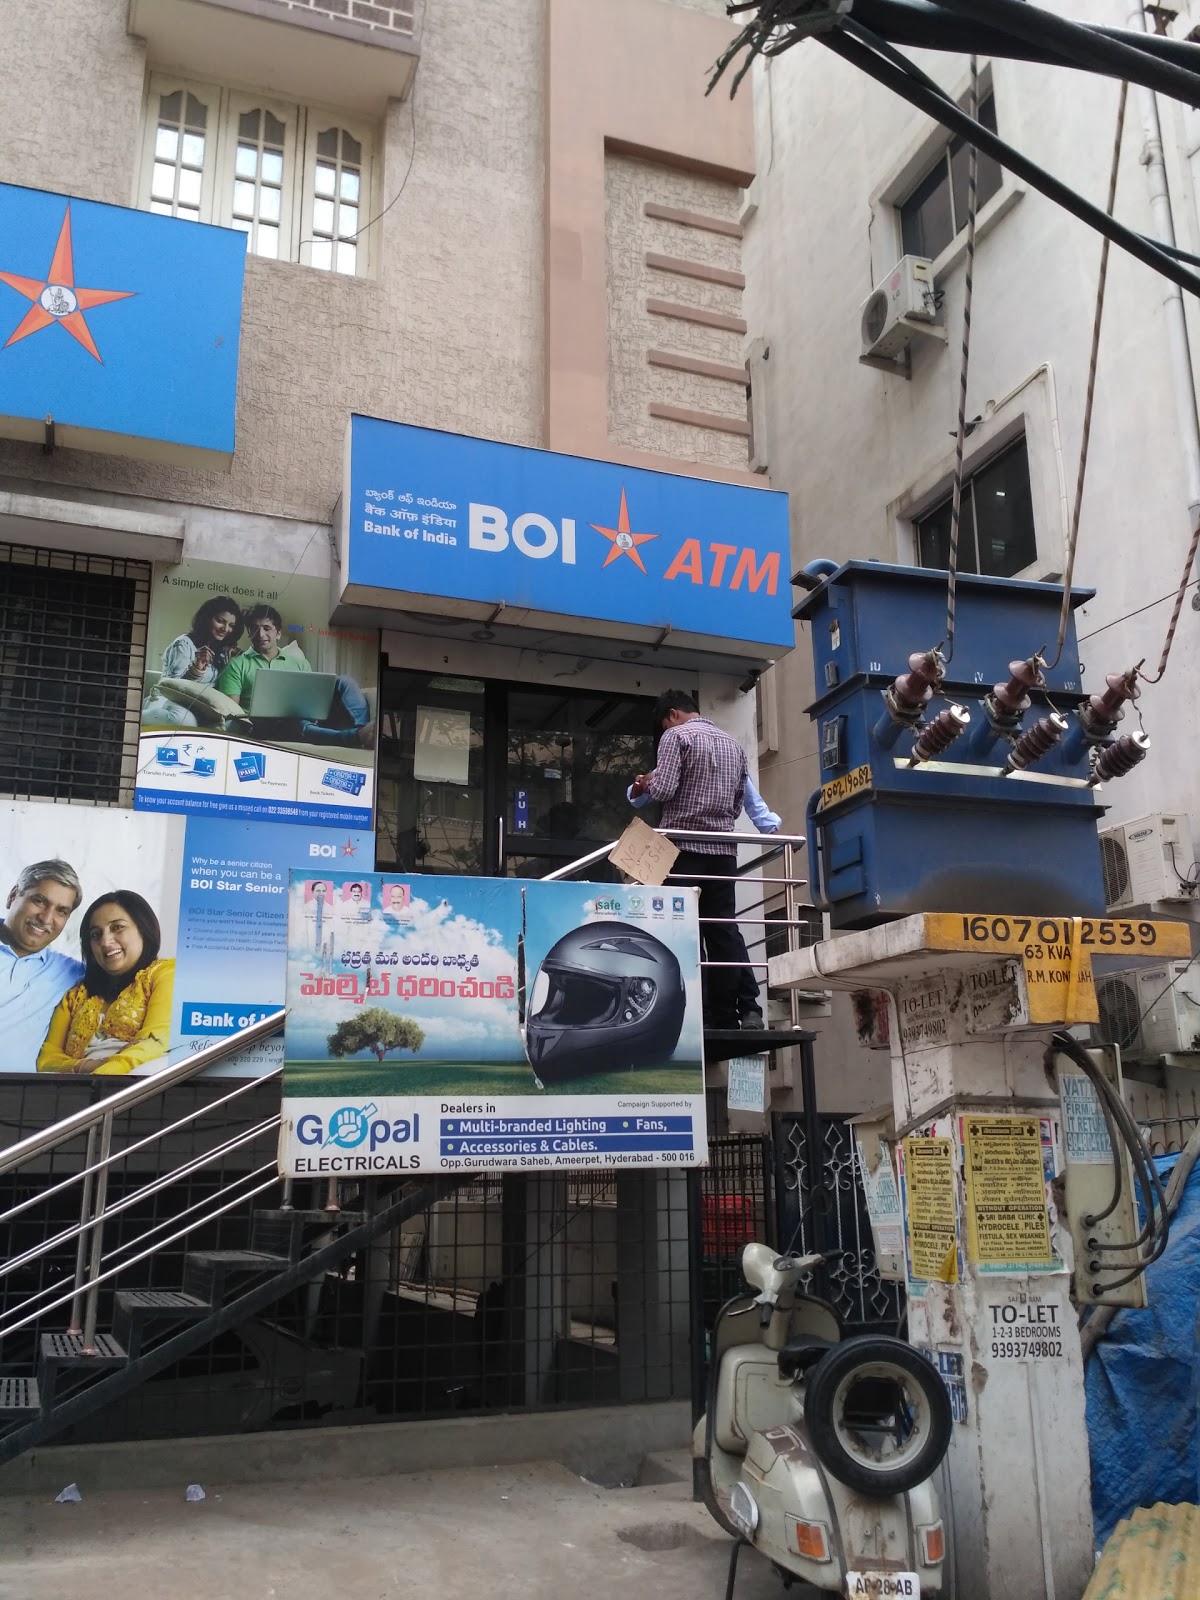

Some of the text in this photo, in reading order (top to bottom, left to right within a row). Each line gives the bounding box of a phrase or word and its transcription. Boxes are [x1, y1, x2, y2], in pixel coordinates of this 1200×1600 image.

[364, 502, 386, 517] बैंक
[421, 513, 457, 528] इंडिया
[364, 520, 457, 546] Bank of India
[468, 502, 576, 565] BOI
[663, 538, 781, 596] ATM
[162, 575, 169, 584] A
[172, 577, 204, 589] simple
[207, 582, 229, 593] click
[232, 586, 254, 597] does
[257, 589, 264, 599] it
[138, 795, 143, 803] To
[144, 796, 156, 804] know
[167, 798, 184, 807] account
[185, 799, 202, 807] balance
[210, 801, 218, 809] free
[219, 802, 227, 811] give
[238, 804, 253, 813] missed
[268, 806, 276, 814] 022
[299, 809, 309, 817] from
[309, 811, 318, 819] your
[319, 811, 339, 820] registered
[354, 814, 368, 822] number
[518, 791, 526, 829] PUH
[309, 844, 336, 858] BOI
[191, 857, 208, 866] Why
[209, 858, 219, 866] be
[227, 859, 248, 867] senior
[250, 861, 273, 869] citizen
[191, 867, 282, 881] when you can be a
[190, 879, 284, 894] BOI Star Senior
[188, 907, 204, 915] BOI
[207, 908, 224, 916] Star
[226, 909, 253, 917] Senior
[255, 911, 284, 919] Citizen
[963, 916, 1157, 946] 1607012539
[1024, 944, 1072, 960] 63 KVA
[341, 951, 479, 972] భద్రత మన అందరి బాధ్యత
[396, 975, 515, 1001] ధరించండి
[901, 989, 943, 1014] TO-LET
[191, 1011, 234, 1027] Bank
[238, 1013, 257, 1028] of
[440, 1103, 496, 1114] Dealers in
[617, 1100, 692, 1109] Campaign Supported by
[459, 1119, 667, 1133] Multi-branded Lighting Fans,
[459, 1139, 598, 1154] Accessories & Cables.
[294, 1155, 421, 1173] ELECTRICALS
[440, 1152, 695, 1169] Opp.Gurudwara Saheb, Ameerpet, Hyderabad 500 016
[1024, 1222, 1045, 1230] PILES
[989, 1305, 1059, 1324] TO-LET
[992, 1326, 1061, 1338] 1-2-3 BEDROOMS
[991, 1341, 1063, 1359] 9393749802
[895, 1578, 913, 1595] AB
